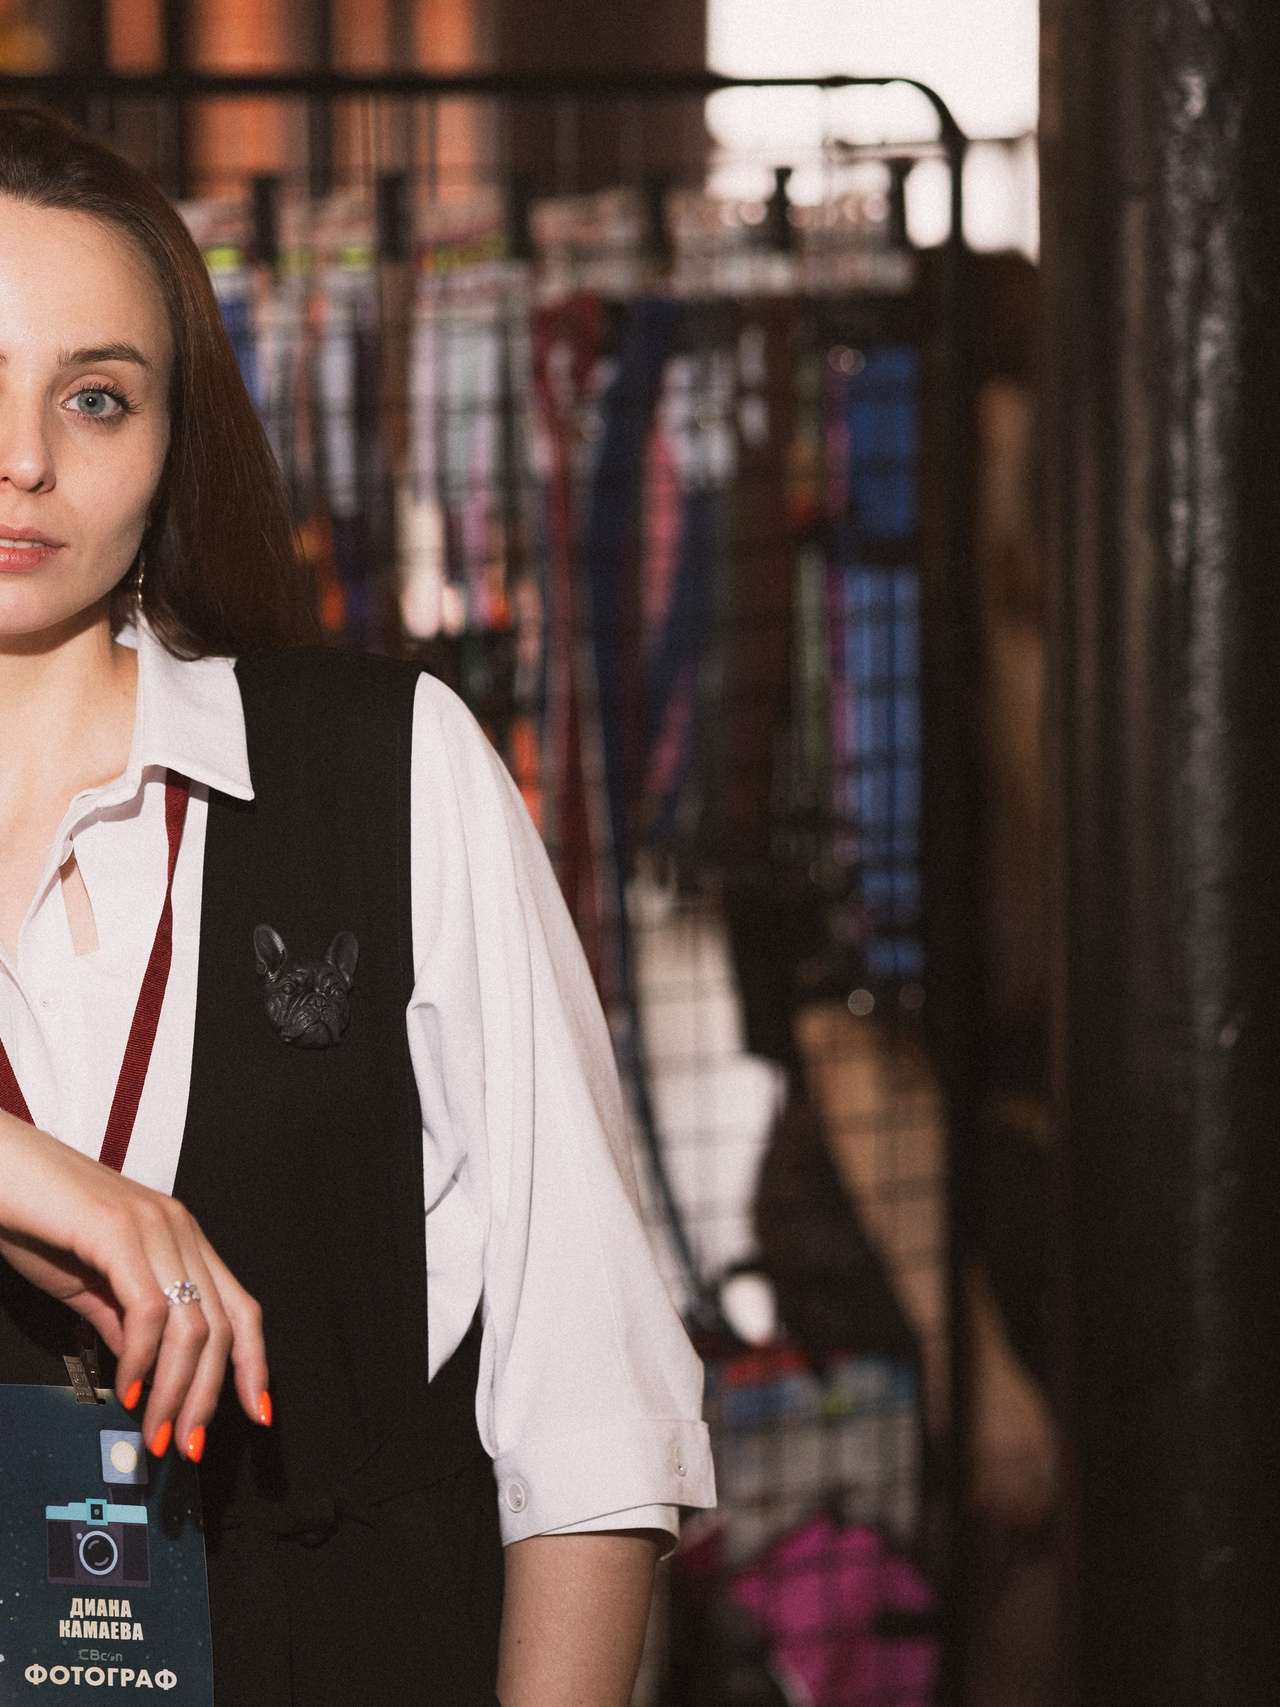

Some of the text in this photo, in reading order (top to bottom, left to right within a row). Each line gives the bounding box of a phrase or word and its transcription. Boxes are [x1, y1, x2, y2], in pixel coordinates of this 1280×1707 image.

[70, 1597, 132, 1619] ДИАНА
[59, 1619, 144, 1641] КАМАЕВА
[24, 1663, 178, 1691] ФОТОГРАФ
